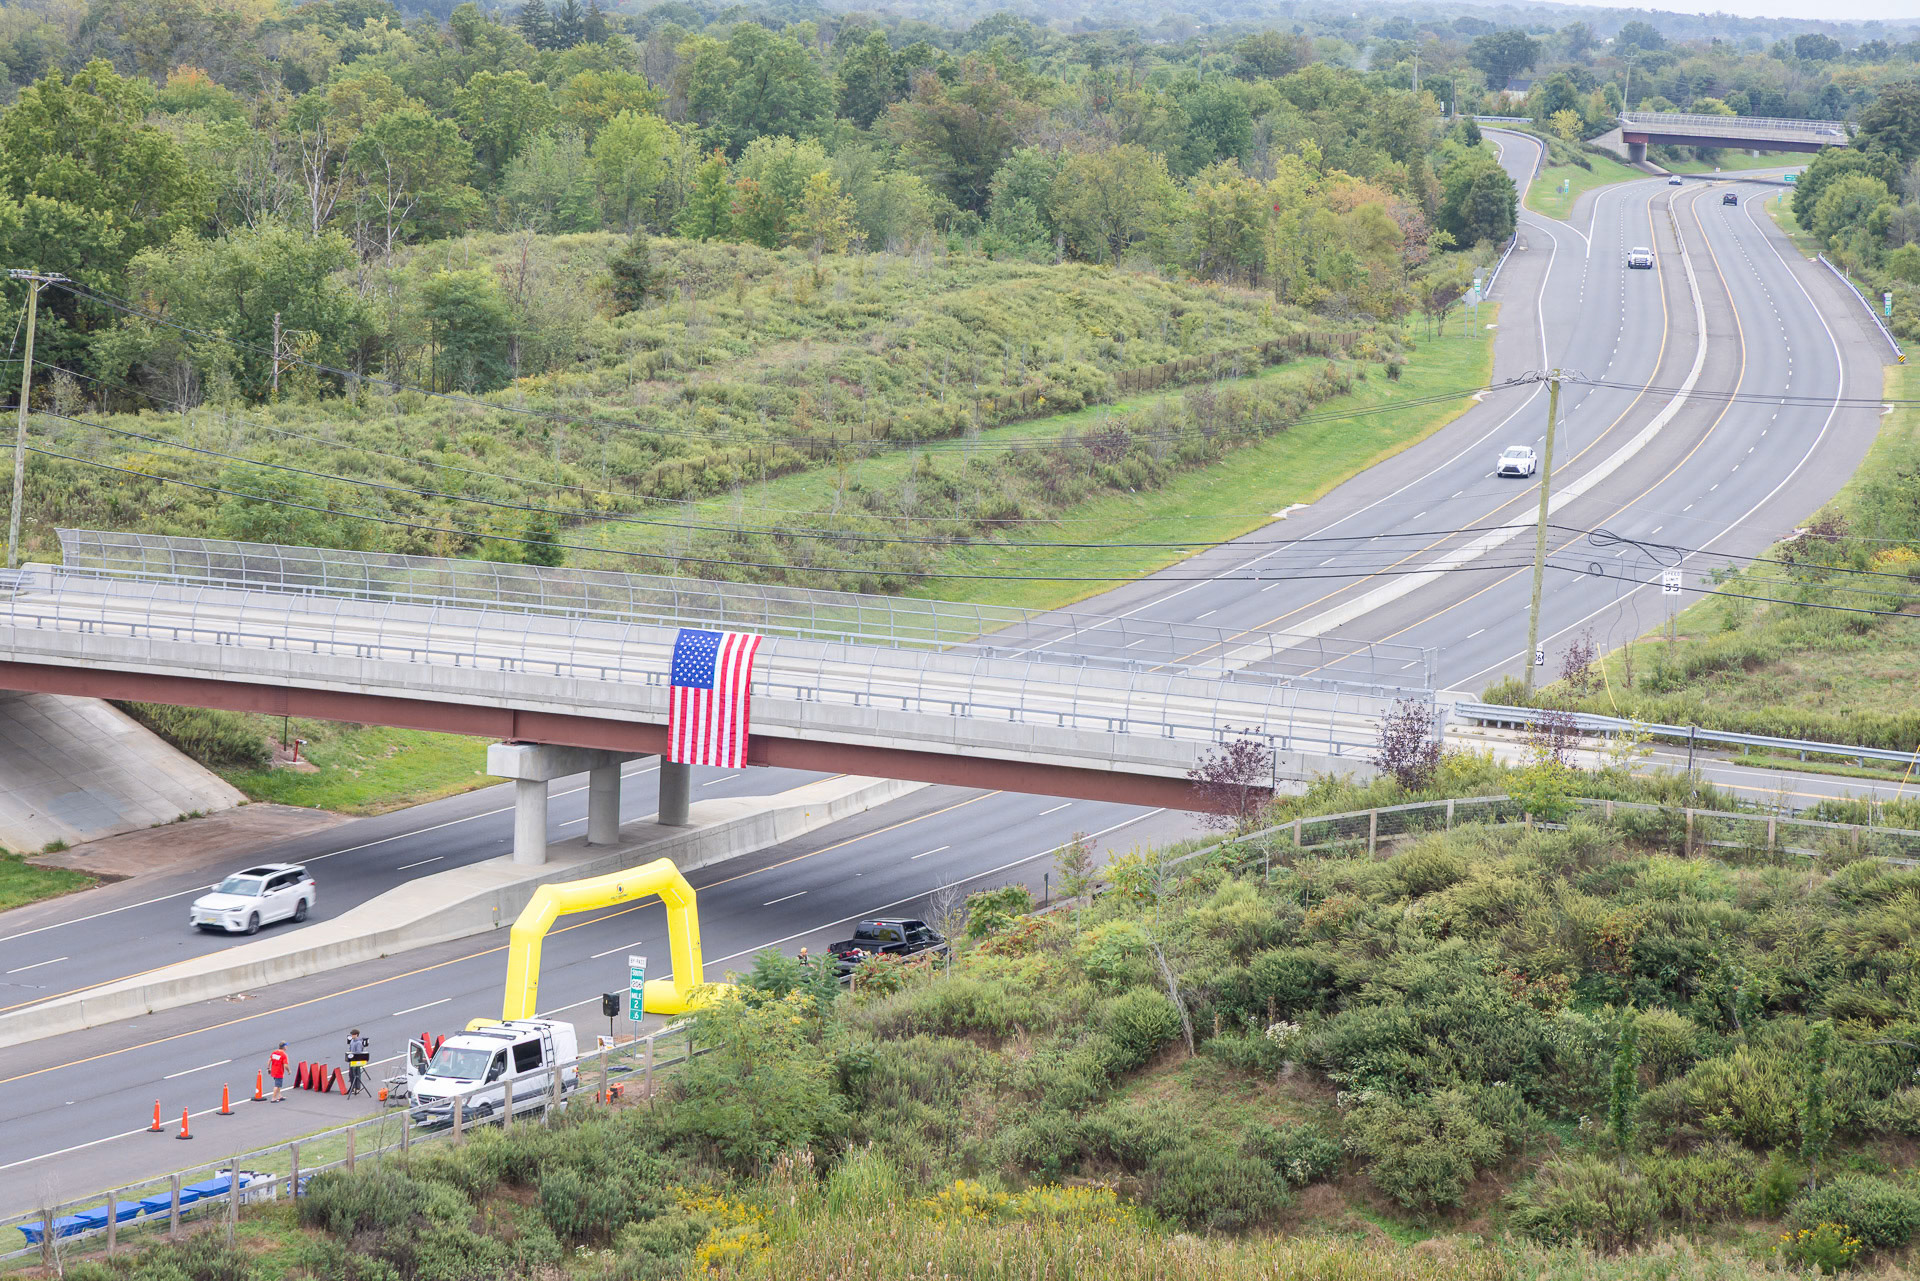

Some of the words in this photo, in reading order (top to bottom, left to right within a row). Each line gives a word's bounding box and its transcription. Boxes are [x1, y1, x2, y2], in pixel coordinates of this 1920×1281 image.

[1665, 583, 1679, 591] 55
[631, 980, 643, 989] 206
[631, 992, 642, 1000] MILE
[634, 1000, 639, 1009] 2
